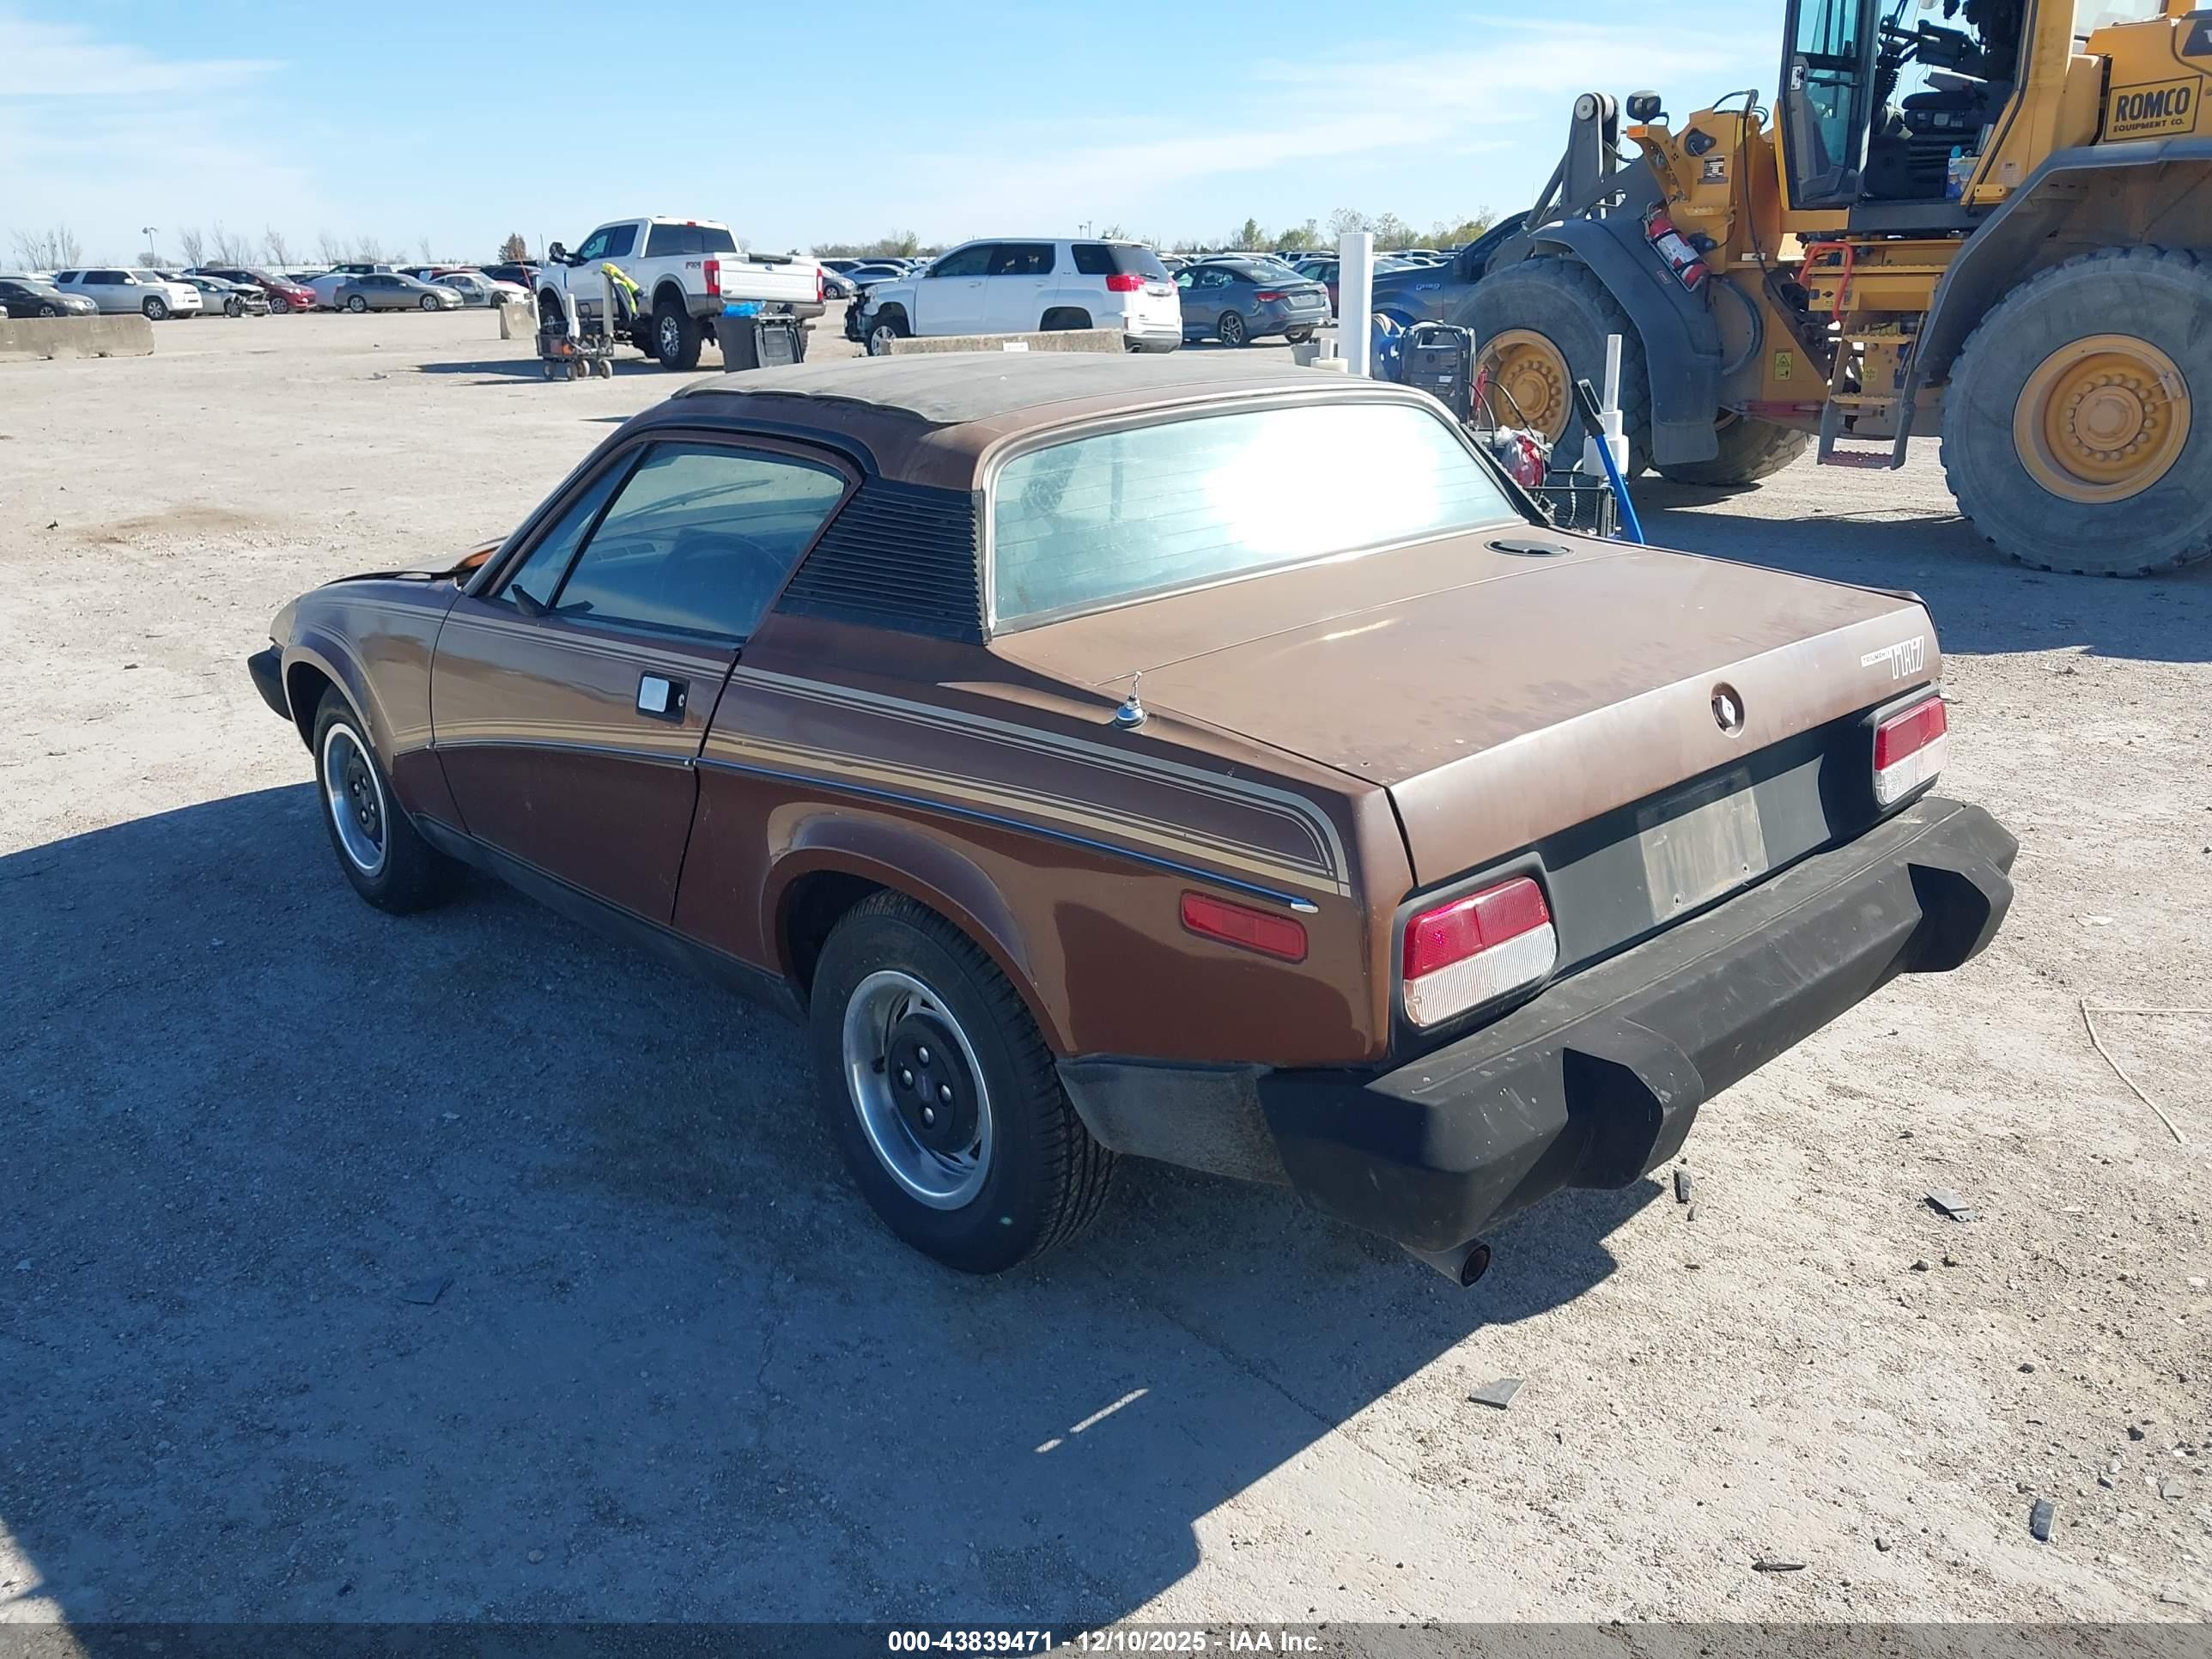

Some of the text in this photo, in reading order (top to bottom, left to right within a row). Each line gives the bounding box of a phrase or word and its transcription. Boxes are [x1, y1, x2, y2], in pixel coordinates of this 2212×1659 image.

[2115, 87, 2191, 123] ROMCO
[2113, 118, 2185, 133] EQUIPMENT CO.
